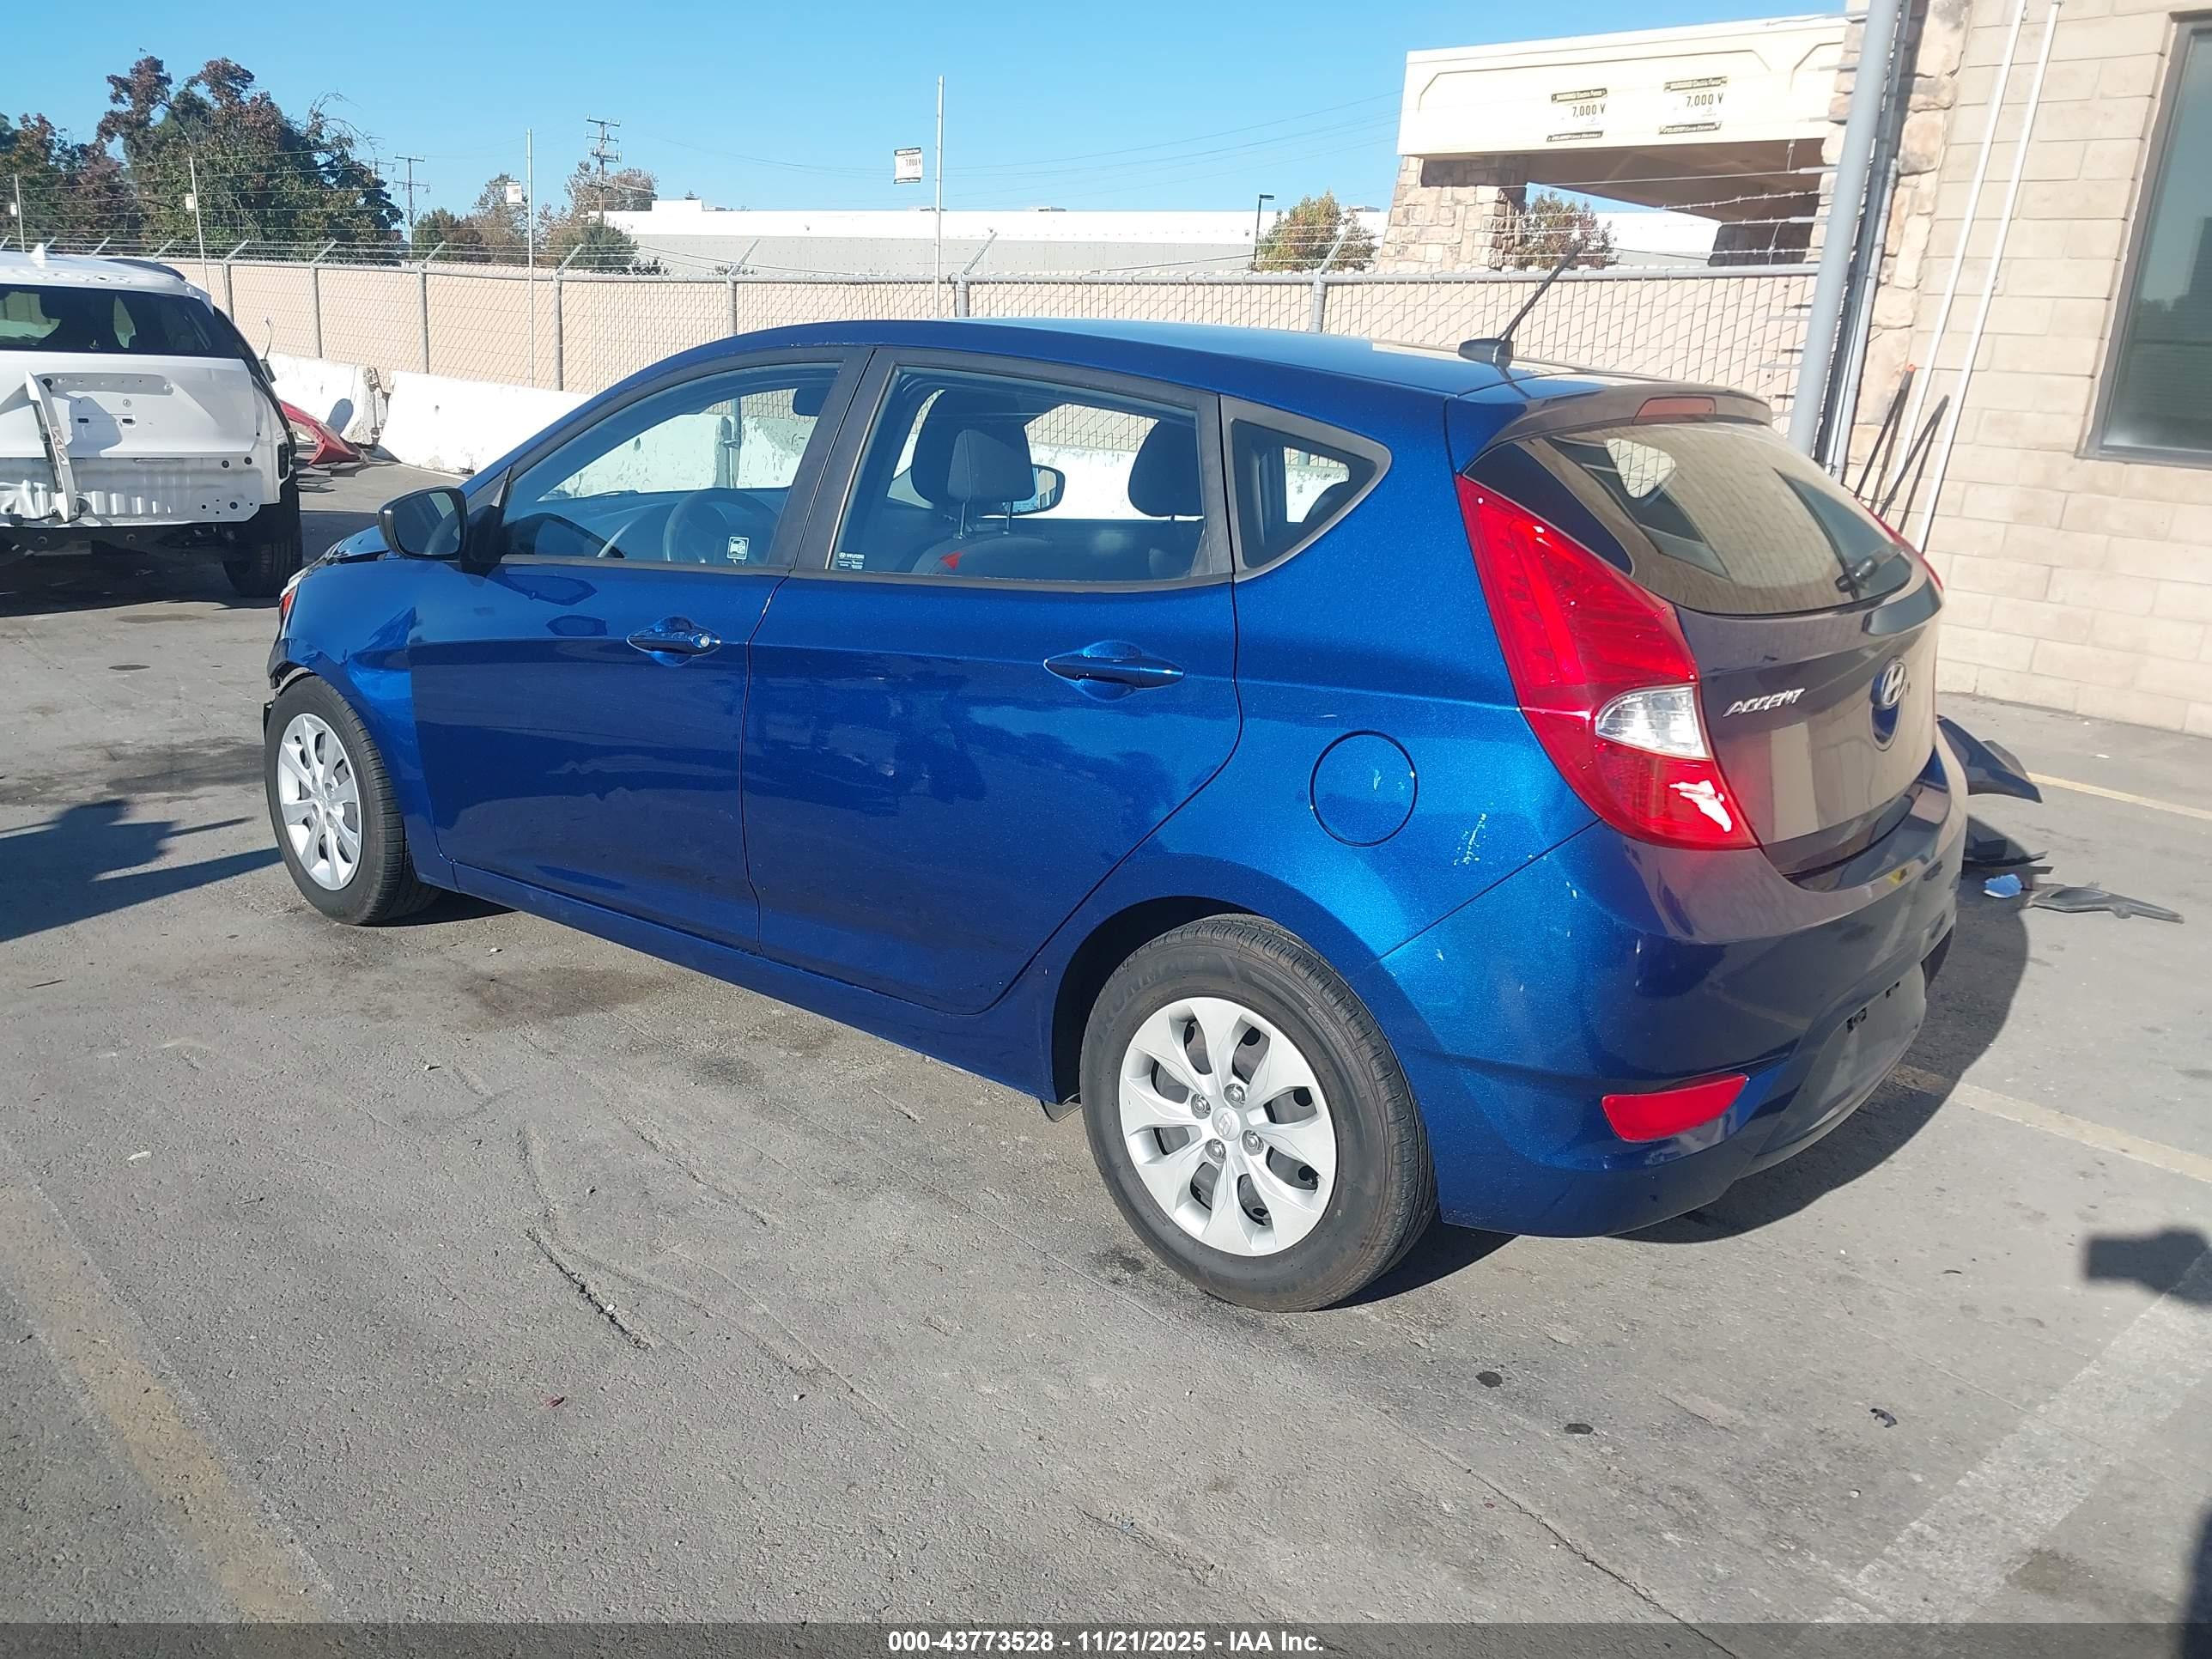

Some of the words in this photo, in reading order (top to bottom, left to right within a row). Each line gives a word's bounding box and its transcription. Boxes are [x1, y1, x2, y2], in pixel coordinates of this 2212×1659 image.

[1686, 94, 1714, 107] 7,000
[1717, 93, 1724, 104] V
[1572, 104, 1597, 118] 7,000
[1600, 103, 1606, 114] V
[1723, 687, 1806, 717] ACCENT
